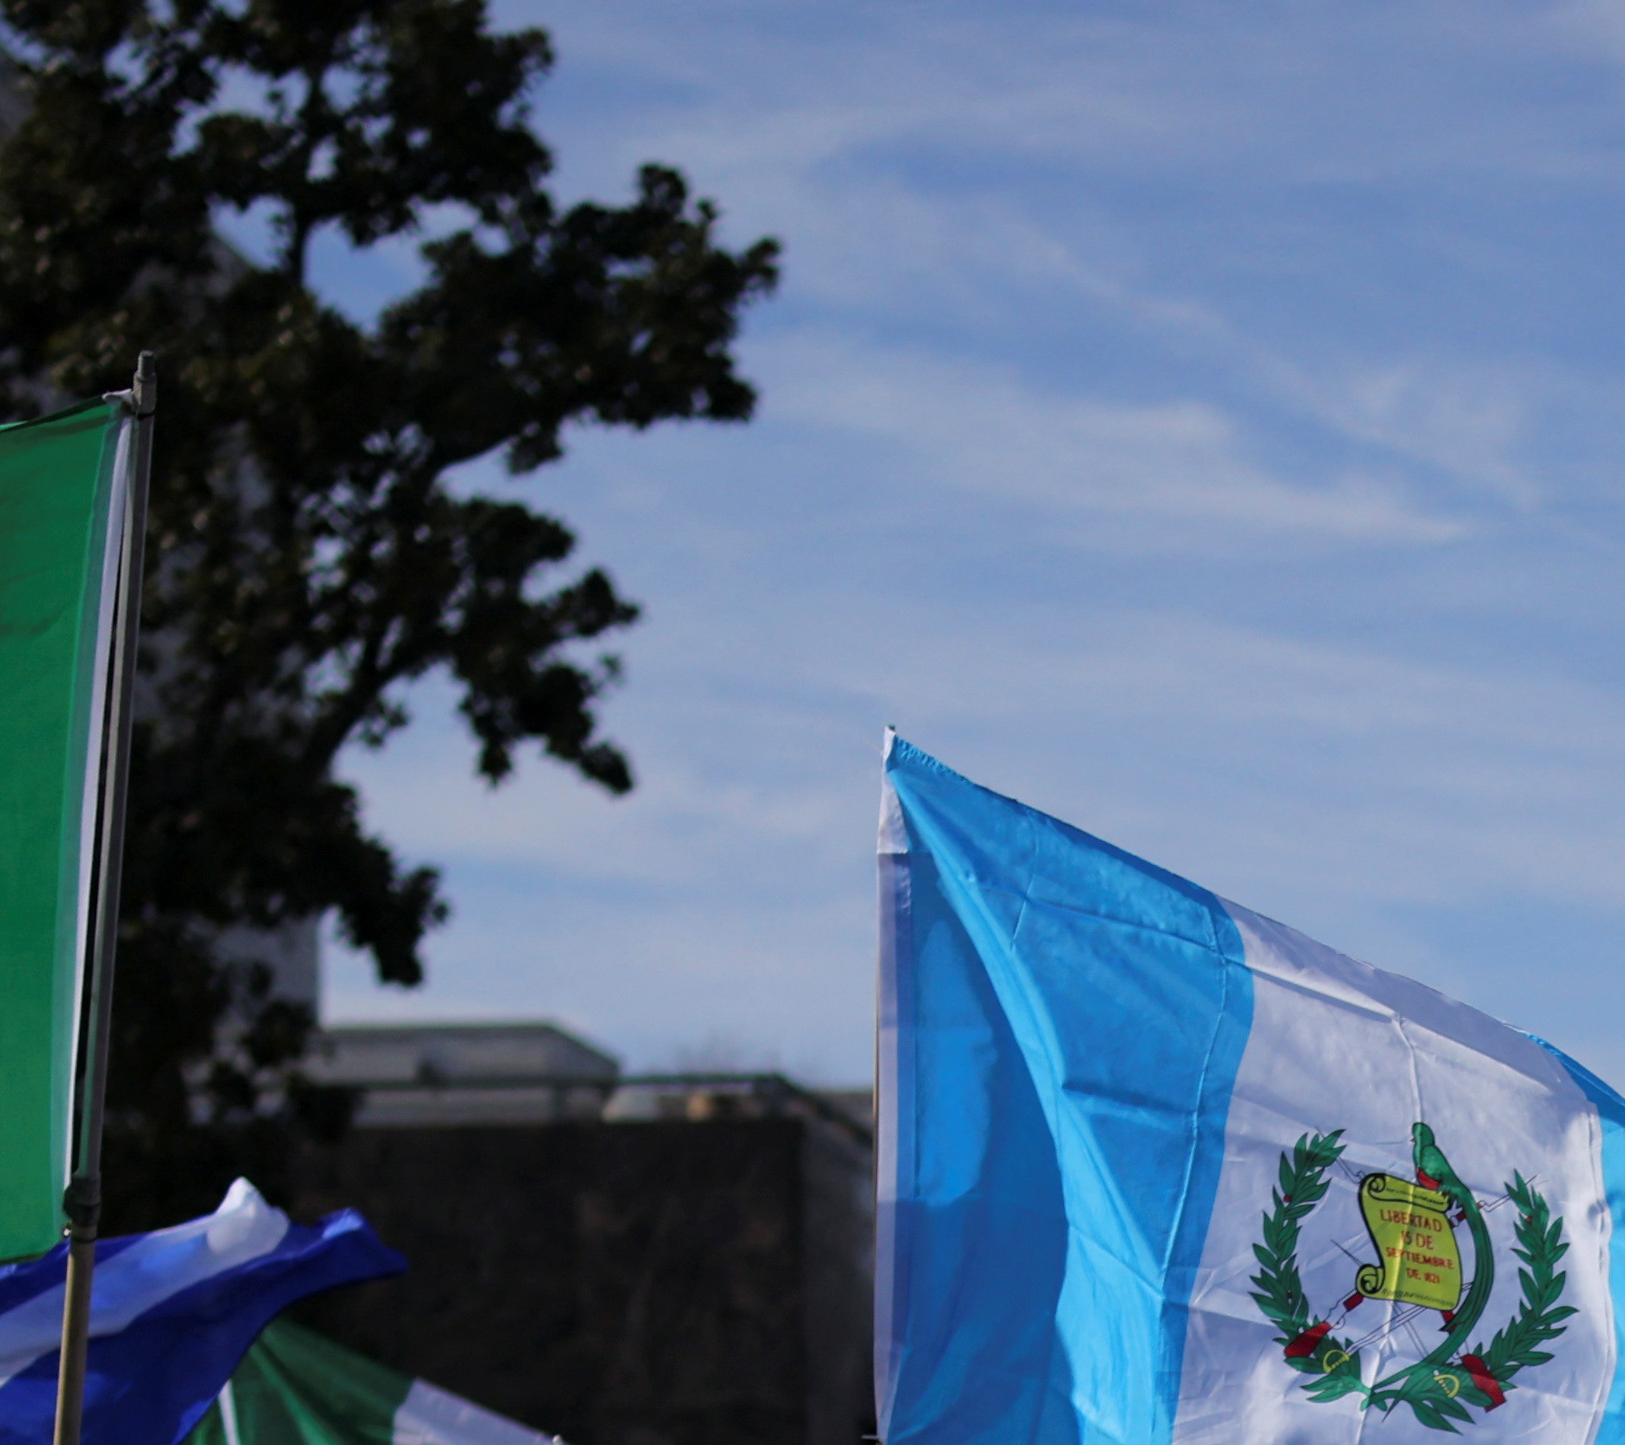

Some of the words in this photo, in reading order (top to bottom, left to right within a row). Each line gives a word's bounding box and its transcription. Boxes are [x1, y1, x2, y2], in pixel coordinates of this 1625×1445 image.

[1380, 1209, 1442, 1232] LIBERTAD
[1416, 1233, 1433, 1250] DE
[1385, 1246, 1454, 1269] SEPTIEMBRE
